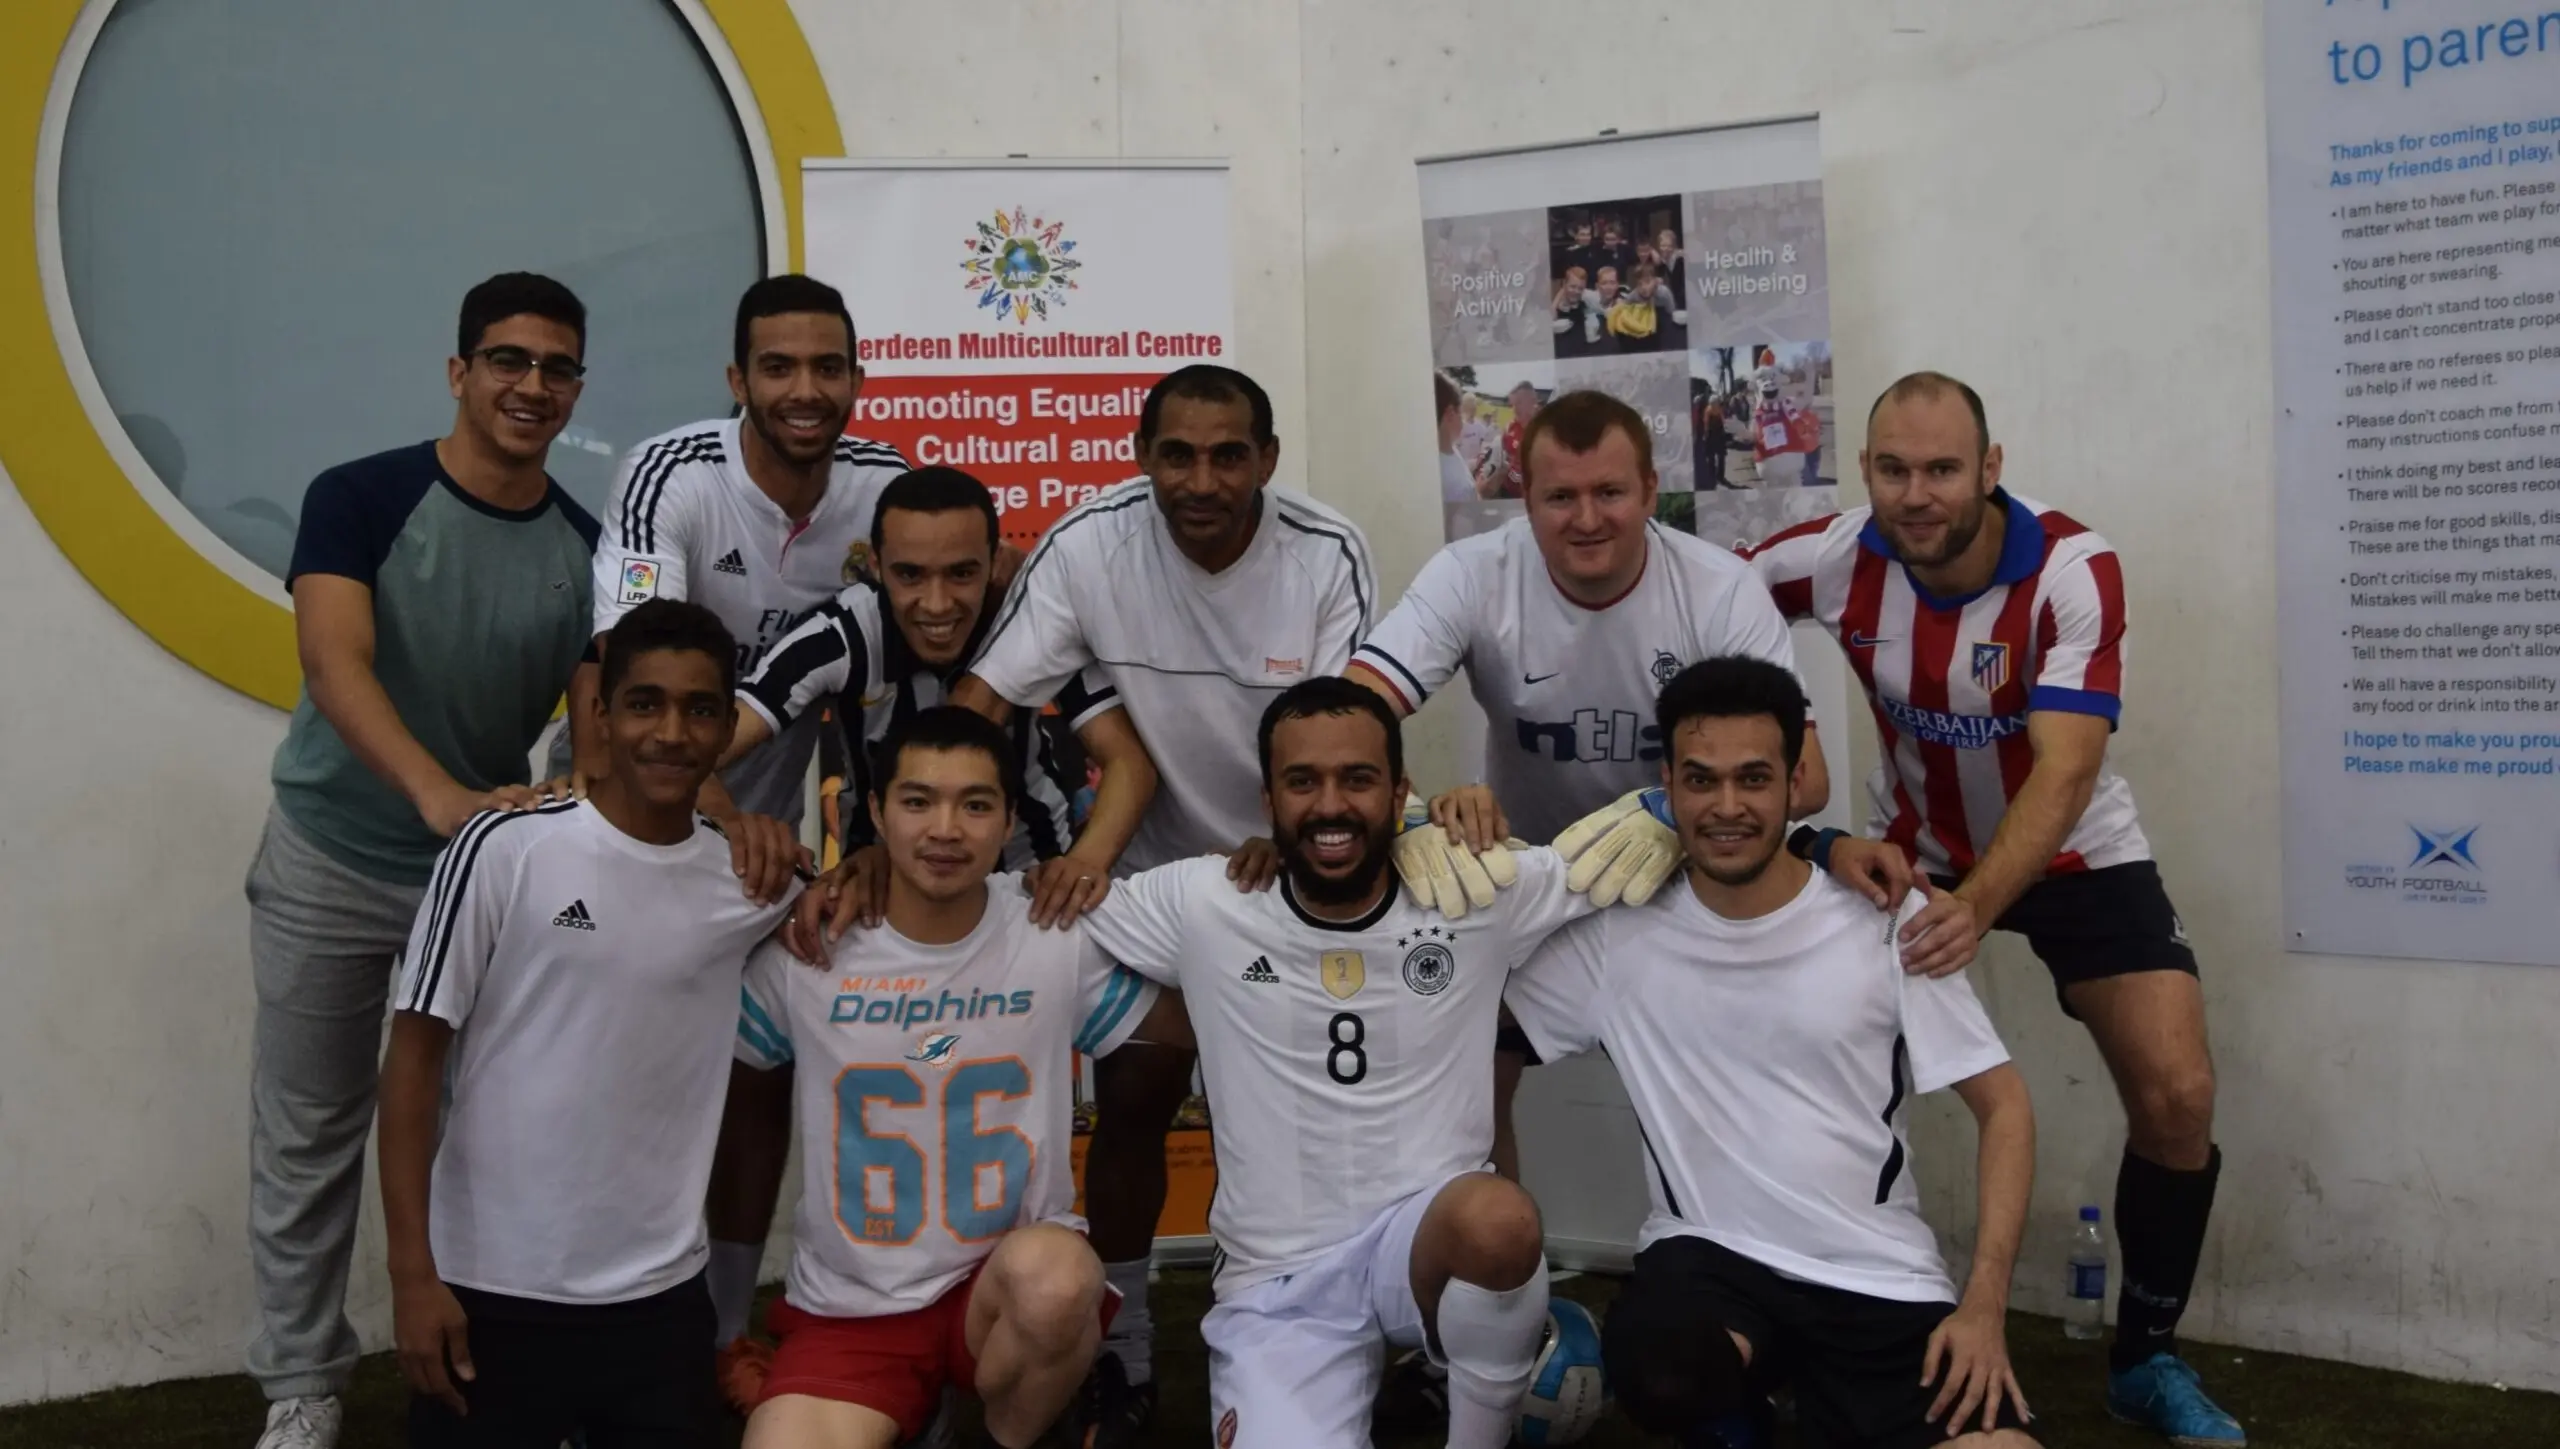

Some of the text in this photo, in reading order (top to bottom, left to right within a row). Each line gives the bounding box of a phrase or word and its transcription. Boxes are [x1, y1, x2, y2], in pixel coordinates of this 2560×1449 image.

[2328, 41, 2382, 84] to
[2330, 122, 2522, 161] Thanks for coming to
[2330, 170, 2352, 188] As
[2356, 167, 2384, 186] my
[2388, 155, 2454, 180] friends
[2458, 148, 2492, 169] and
[2508, 144, 2554, 166] play,
[2349, 204, 2372, 219] am
[2376, 199, 2409, 215] here
[2412, 197, 2427, 211] to
[2430, 191, 2466, 209] have
[2470, 188, 2500, 202] fun.
[2503, 181, 2556, 198] Please
[2342, 222, 2390, 240] matter
[2394, 216, 2431, 234] what
[2435, 213, 2473, 229] team
[2477, 210, 2499, 223] we
[2503, 204, 2536, 224] play
[1704, 243, 1798, 271] Health &
[2341, 235, 2560, 273] You are here representing me
[1451, 269, 1526, 293] Positive
[1698, 270, 1808, 298] Wellbeing
[2342, 262, 2503, 293] shouting or swearing.
[1454, 295, 1527, 319] Activity
[2343, 291, 2555, 324] Please don't stand too close
[2344, 330, 2371, 345] and
[2383, 323, 2419, 341] can't
[2423, 316, 2515, 337] concentrate
[959, 331, 1129, 360] Multicultural
[1135, 330, 1222, 358] Centre
[2344, 348, 2524, 377] There are no referees so
[2345, 384, 2363, 397] us
[2366, 378, 2398, 397] help
[2401, 377, 2412, 391] if
[2416, 376, 2437, 390] we
[2441, 372, 2478, 389] need
[855, 389, 1019, 426] romoting
[2346, 401, 2553, 429] Please don't coach me from
[916, 432, 1136, 466] Cultural and
[2347, 423, 2546, 451] many instructions confuse
[2356, 465, 2393, 481] think
[2396, 463, 2438, 480] doing
[2441, 462, 2464, 477] my
[2468, 458, 2501, 474] best
[2506, 456, 2535, 471] and
[2347, 481, 2518, 503] There will be no scores
[2348, 511, 2536, 534] Praise me for good skills,
[2349, 533, 2536, 555] These are the things that
[2350, 565, 2557, 587] Don't criticise my mistakes,
[626, 591, 648, 602] LFP
[2350, 589, 2521, 608] Mistakes will make me
[2352, 621, 2531, 640] Please do challenge any
[2352, 646, 2376, 660] Tell
[2380, 645, 2418, 659] them
[2422, 644, 2452, 659] that
[2457, 646, 2478, 658] we
[2482, 642, 2521, 658] don't
[2352, 675, 2556, 694] We all have a responsibility
[2352, 697, 2539, 716] any food or drink into the
[1921, 730, 1982, 749] OF FIRE
[2353, 731, 2397, 750] hope
[2402, 732, 2421, 748] to
[2425, 731, 2476, 748] make
[2480, 734, 2514, 752] you
[2344, 756, 2553, 777] Please make me proud
[2345, 876, 2488, 893] YOUTH FOOTBALL
[840, 976, 927, 993] MIAMI
[1241, 971, 1280, 984] adidas
[829, 987, 1035, 1031] Dolphins
[1327, 1012, 1367, 1085] 8
[832, 1055, 1036, 1246] 66
[864, 1218, 895, 1237] EST
